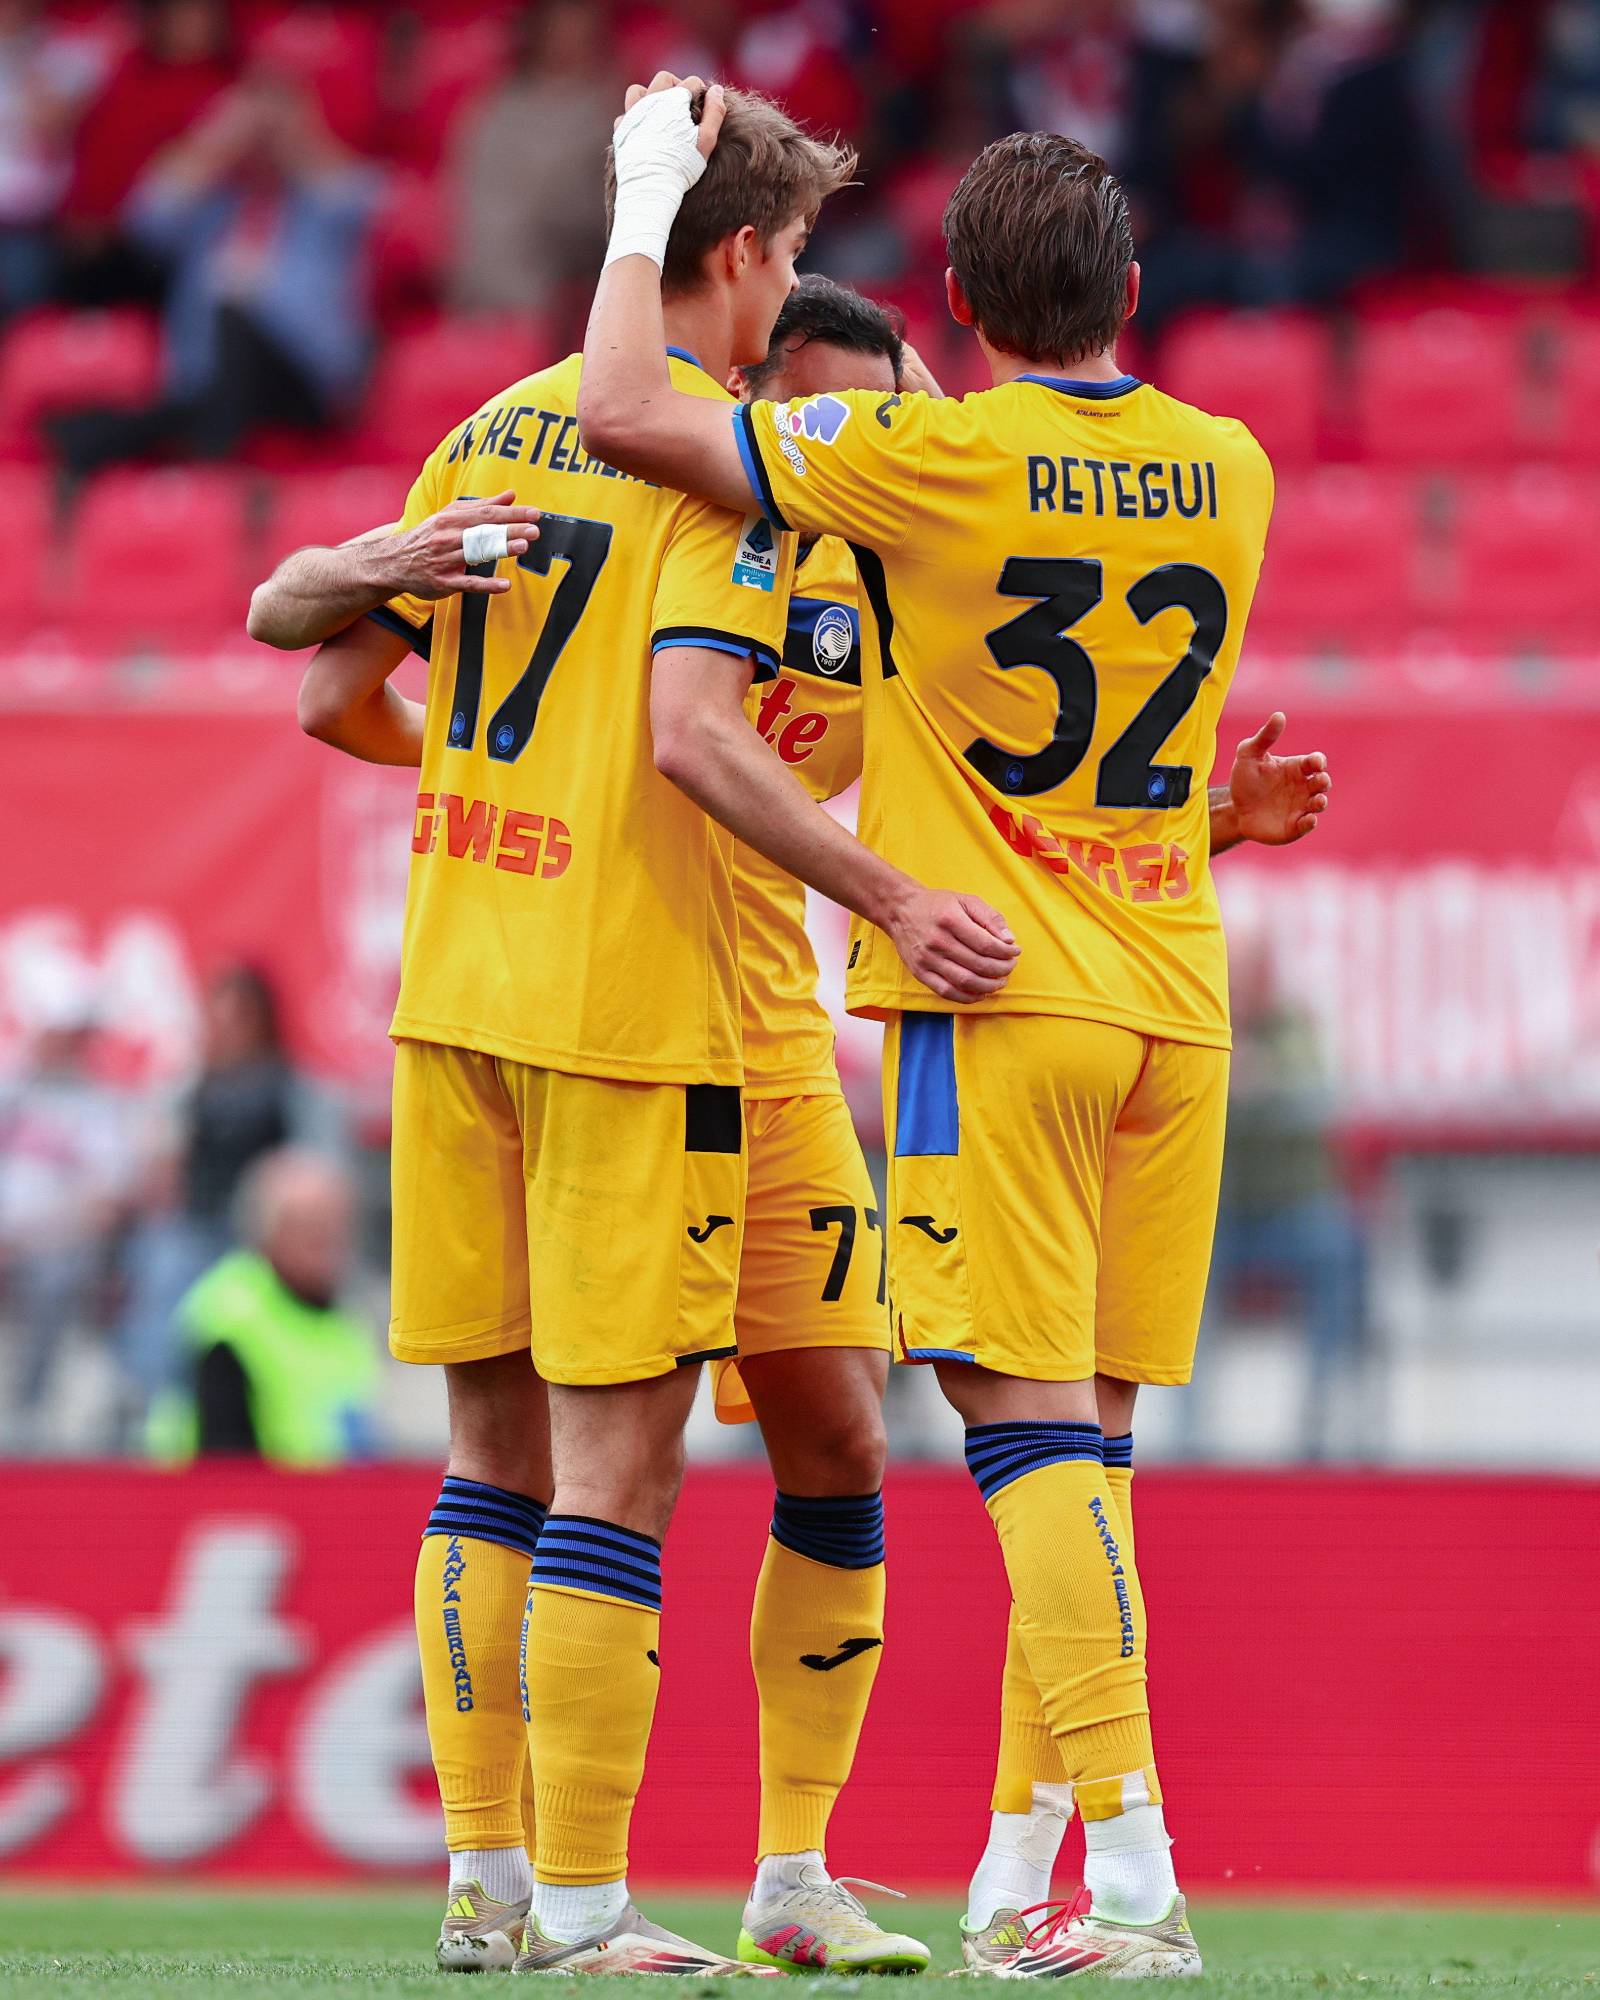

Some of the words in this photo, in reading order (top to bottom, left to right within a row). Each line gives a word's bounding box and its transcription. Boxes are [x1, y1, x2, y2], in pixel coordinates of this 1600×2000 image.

[477, 406, 663, 489] KETEL
[775, 404, 806, 476] acrypto
[1027, 455, 1218, 519] RETEGUI
[741, 551, 765, 564] SERIE
[765, 558, 772, 566] A
[741, 567, 766, 578] enilive
[446, 495, 614, 765] 17
[823, 615, 849, 627] ATALANTA
[820, 657, 837, 667] 1907
[962, 556, 1228, 810] 32
[443, 1535, 466, 1604] LANTA
[1088, 1496, 1125, 1577] ATALANTA
[1112, 1578, 1135, 1658] BERGAMO
[442, 1607, 475, 1713] BERGAMO
